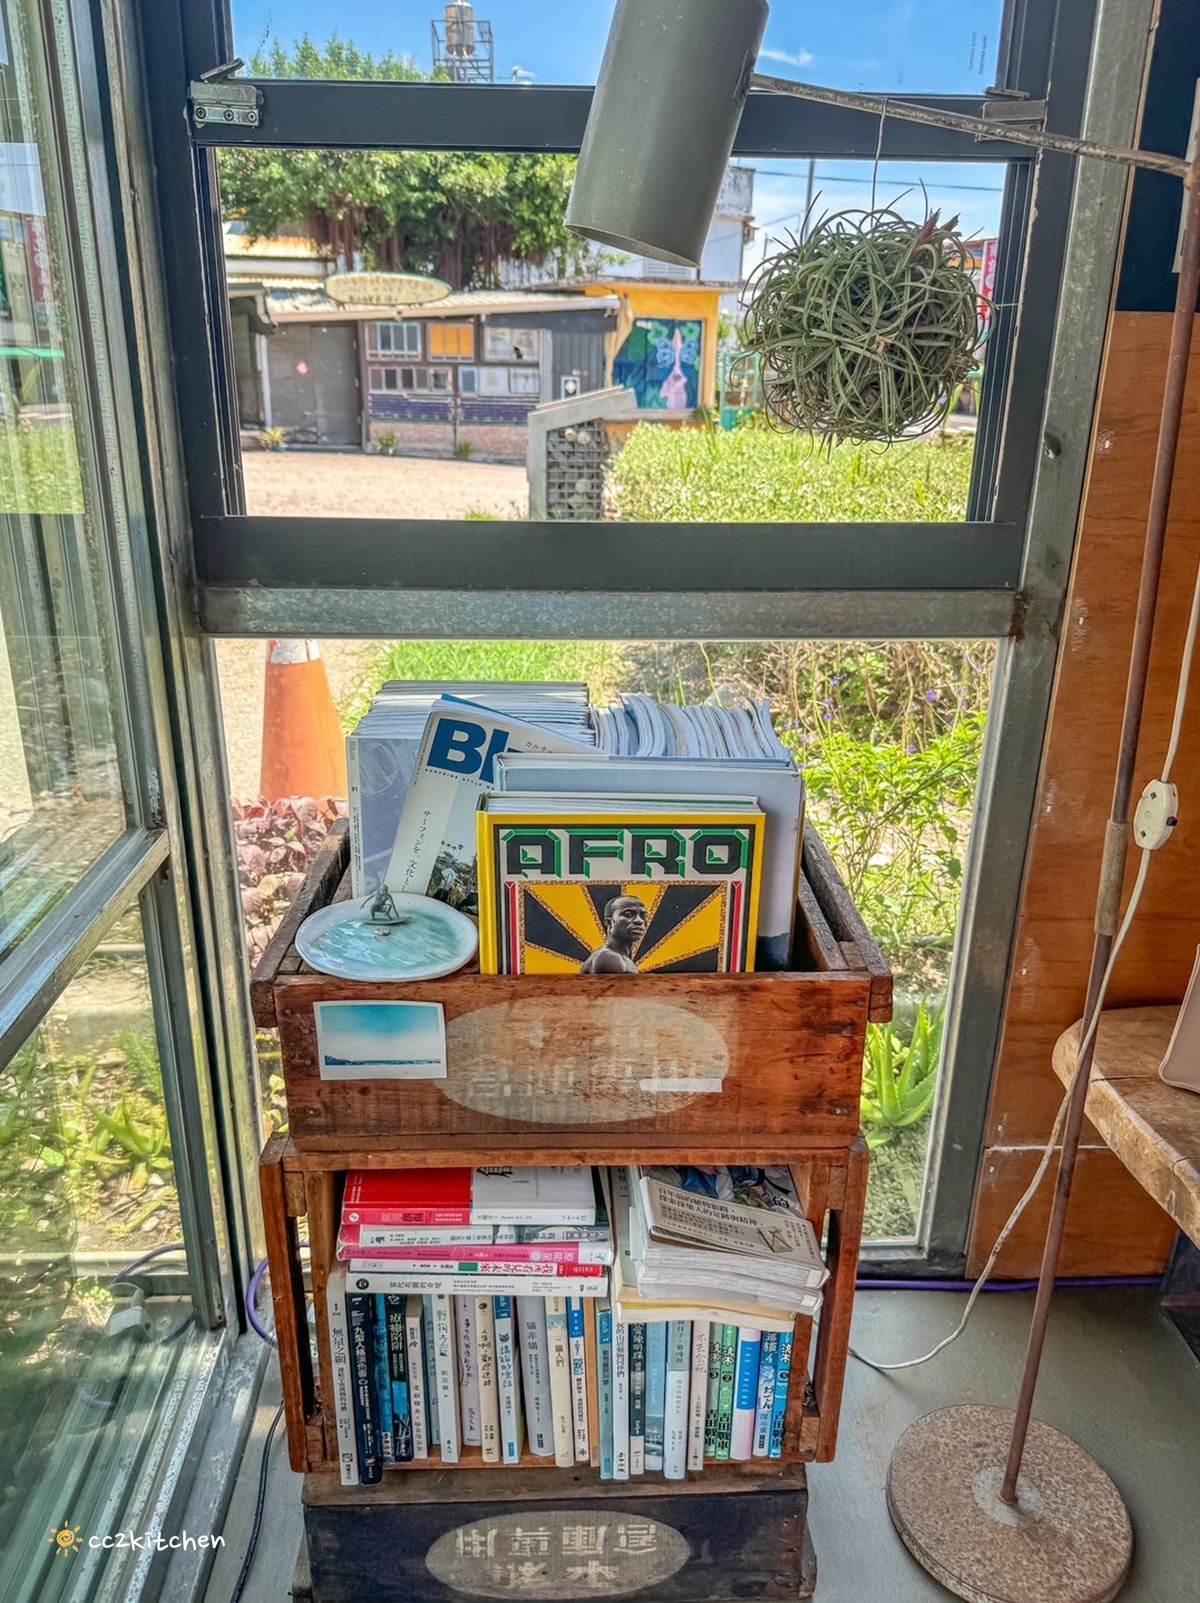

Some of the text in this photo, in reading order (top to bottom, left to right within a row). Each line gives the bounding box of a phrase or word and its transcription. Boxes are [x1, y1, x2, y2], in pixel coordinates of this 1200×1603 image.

[426, 718, 523, 784] Bl
[501, 828, 749, 878] AFRO
[480, 1263, 554, 1276] 我所看見的未來
[572, 1266, 594, 1275] catch
